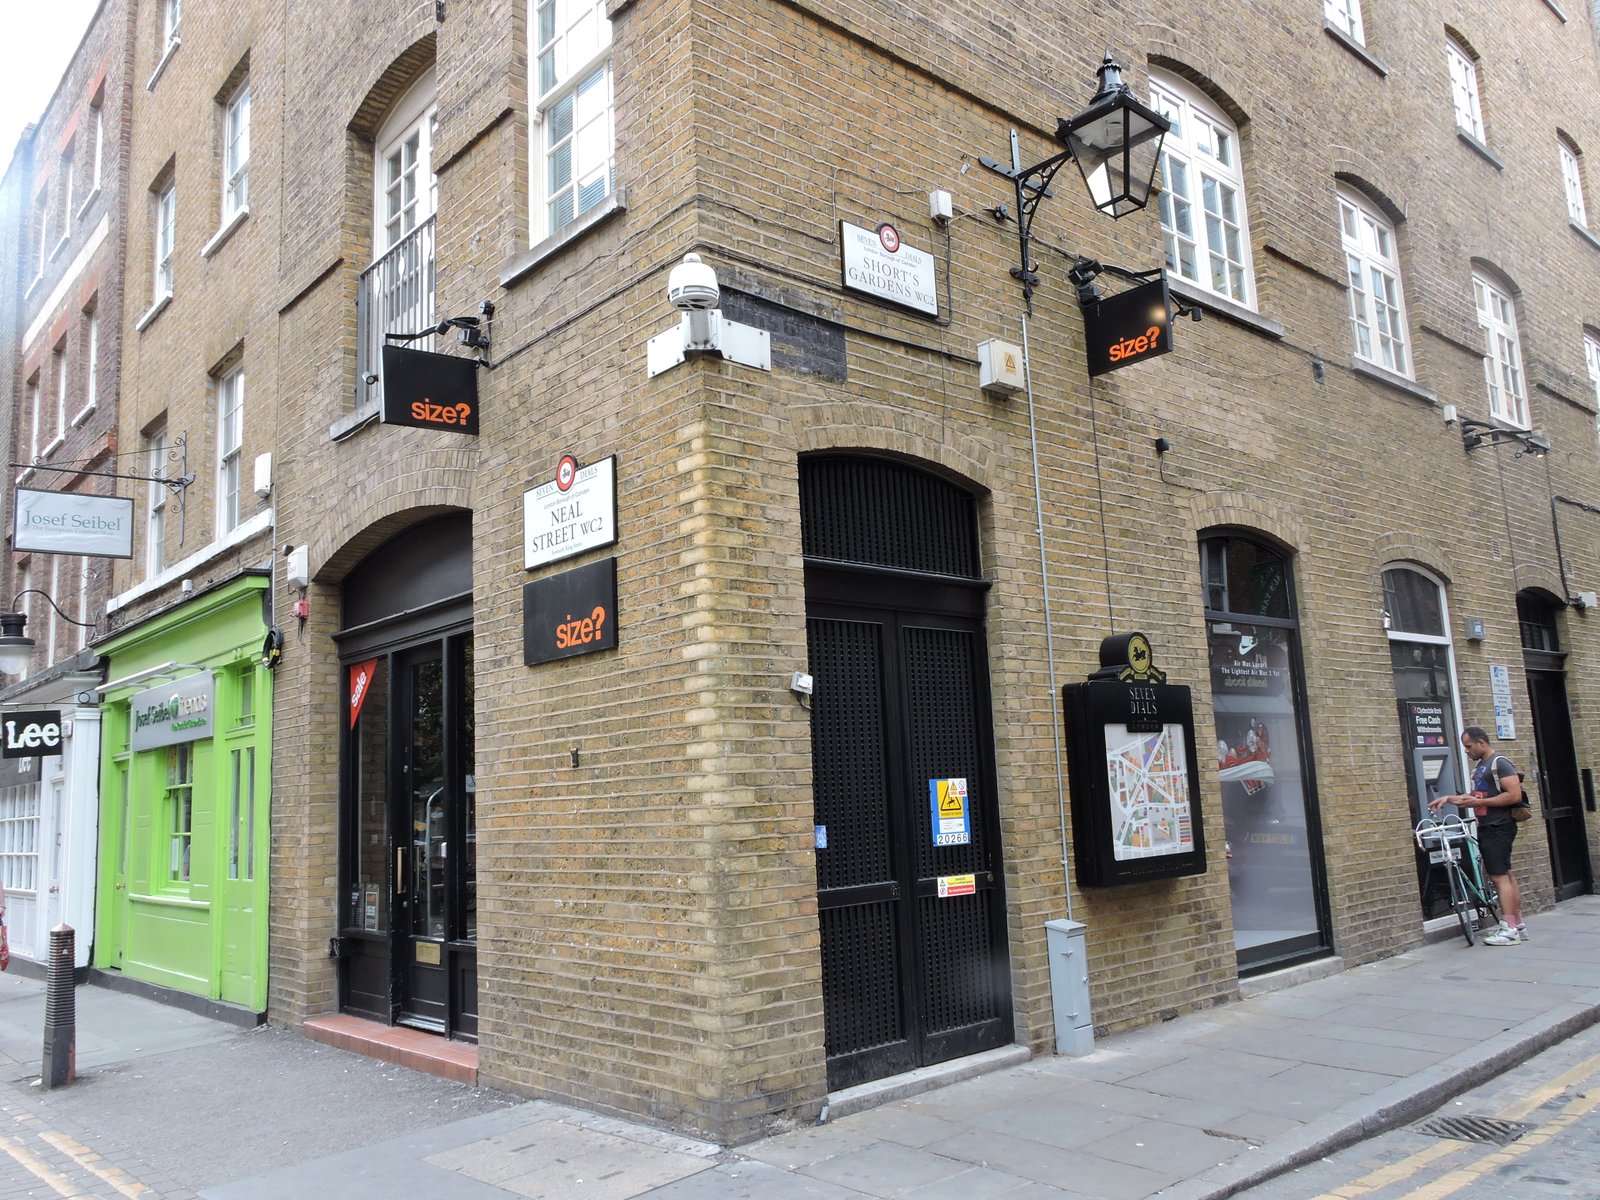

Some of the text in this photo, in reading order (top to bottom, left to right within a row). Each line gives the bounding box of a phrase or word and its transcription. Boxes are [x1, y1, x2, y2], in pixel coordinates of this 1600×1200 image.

[848, 267, 935, 306] GARDENS WC2
[863, 257, 920, 287] SHORT'S
[1109, 326, 1160, 362] size?
[411, 397, 471, 426] size?
[24, 510, 120, 531] Josef Seibel
[551, 501, 583, 527] NEAL
[532, 516, 603, 553] STREET WC2
[556, 606, 606, 649] size?
[1129, 687, 1156, 700] SEVEN
[1130, 701, 1157, 715] DIALS
[1416, 715, 1441, 724] Free Cash
[5, 720, 60, 749] Lee
[938, 833, 968, 844] 20266
